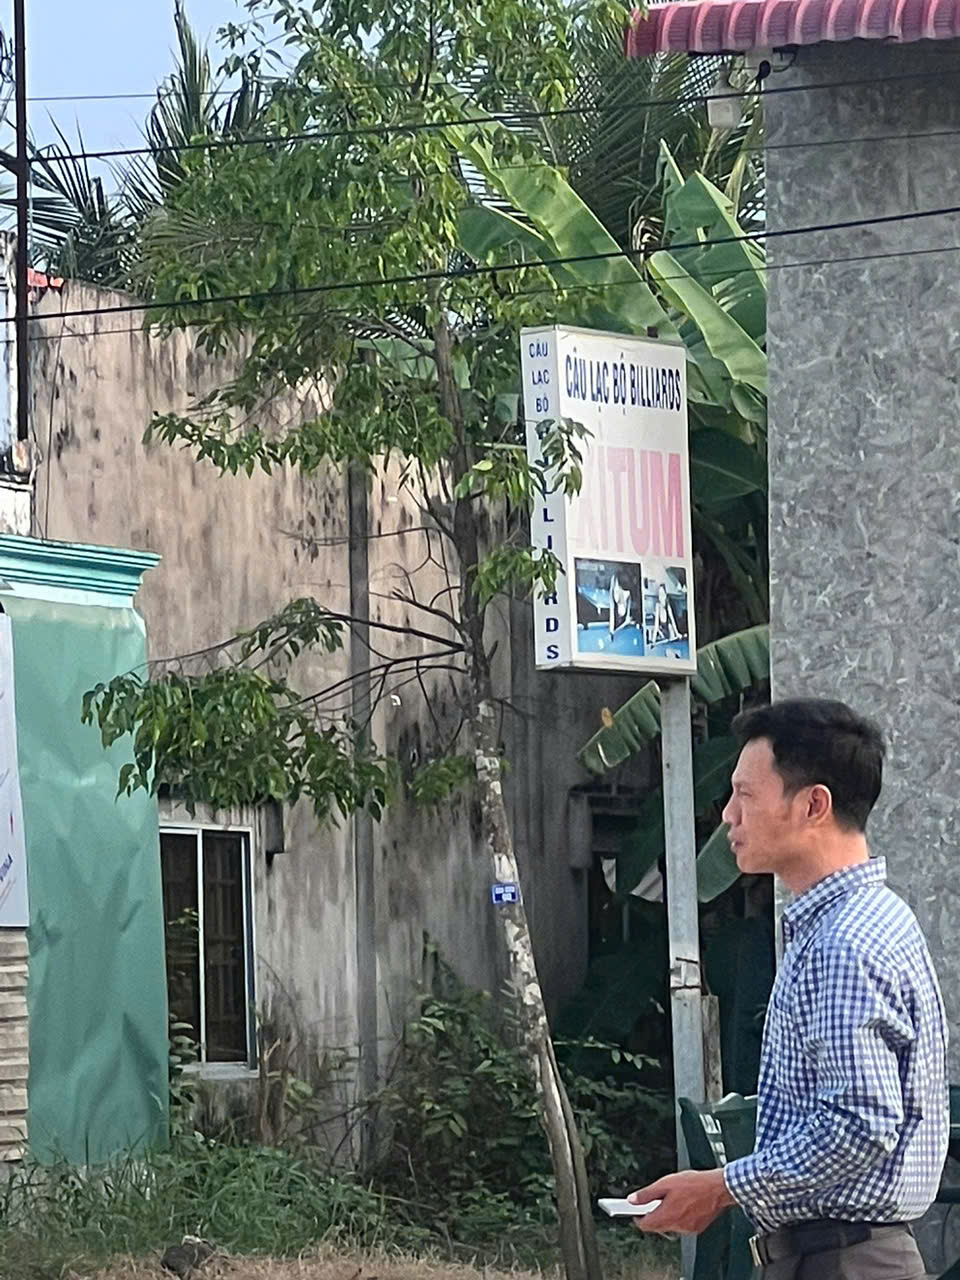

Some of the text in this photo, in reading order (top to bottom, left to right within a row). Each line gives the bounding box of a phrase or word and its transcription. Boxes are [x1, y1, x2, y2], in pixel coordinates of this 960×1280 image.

[565, 346, 682, 415] CÂU LẠC BỘ BILLIARDS
